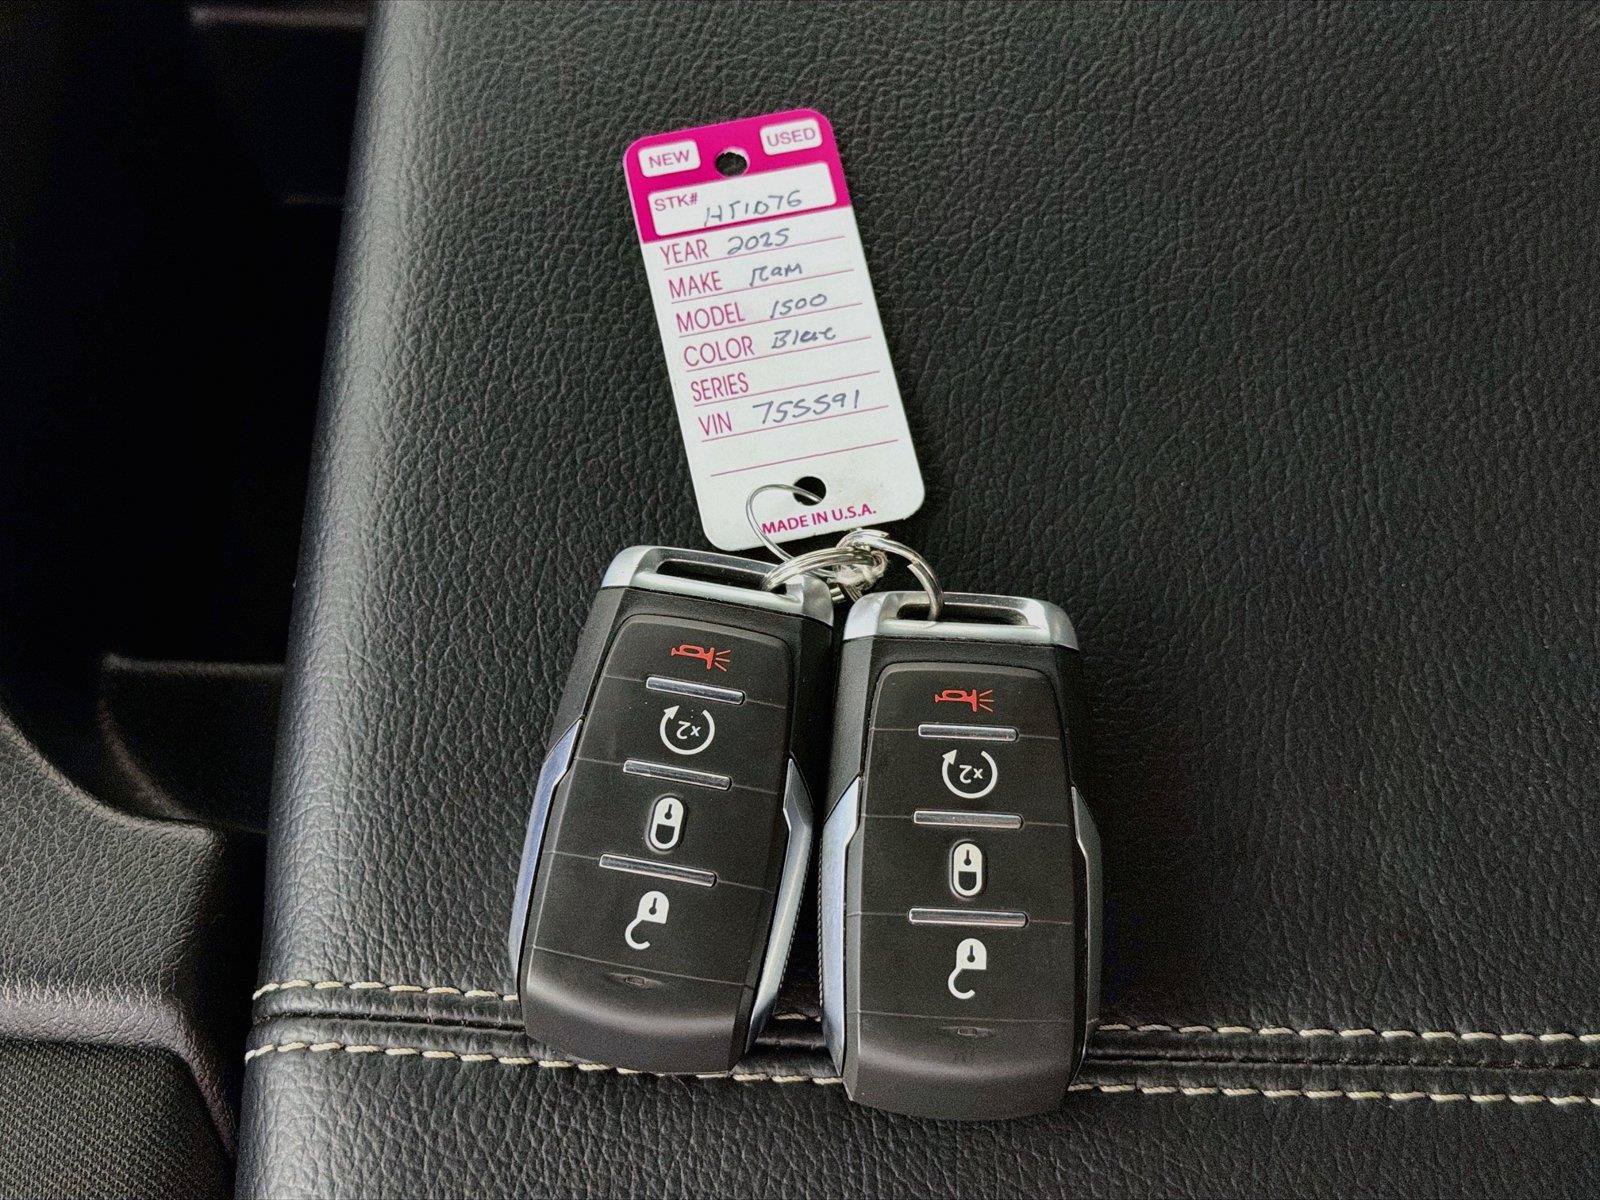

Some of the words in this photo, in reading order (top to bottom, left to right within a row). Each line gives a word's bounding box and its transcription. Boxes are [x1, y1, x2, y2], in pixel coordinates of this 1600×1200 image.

[766, 127, 816, 147] USED
[648, 150, 690, 169] NEW
[654, 192, 699, 212] STK#
[660, 239, 709, 266] YEAR
[726, 227, 790, 255] 2025
[668, 270, 723, 300] MAKE
[676, 301, 746, 334] MODEL
[770, 293, 828, 319] 1500
[683, 335, 755, 367] COLOR
[690, 371, 749, 402] SERIES
[752, 389, 861, 425] 755591
[698, 411, 733, 436] VIN
[762, 514, 809, 535] MADE
[812, 511, 829, 525] IN
[832, 502, 877, 521] U.S.A.
